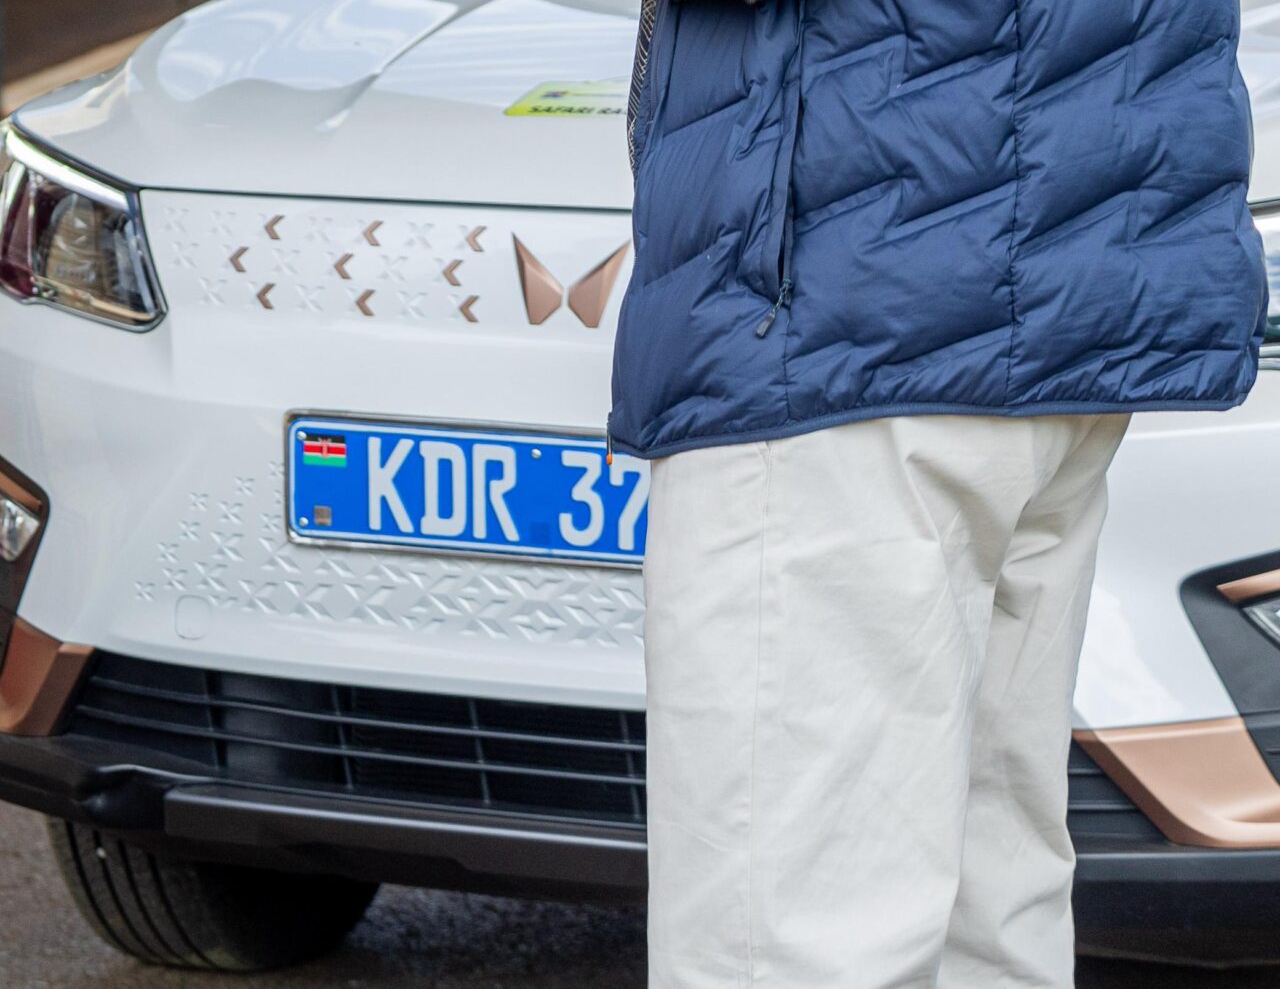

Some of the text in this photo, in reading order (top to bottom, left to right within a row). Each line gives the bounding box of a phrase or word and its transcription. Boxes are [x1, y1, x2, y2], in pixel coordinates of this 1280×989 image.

[528, 105, 596, 115] SAFARI
[367, 436, 652, 552] KDR 37
